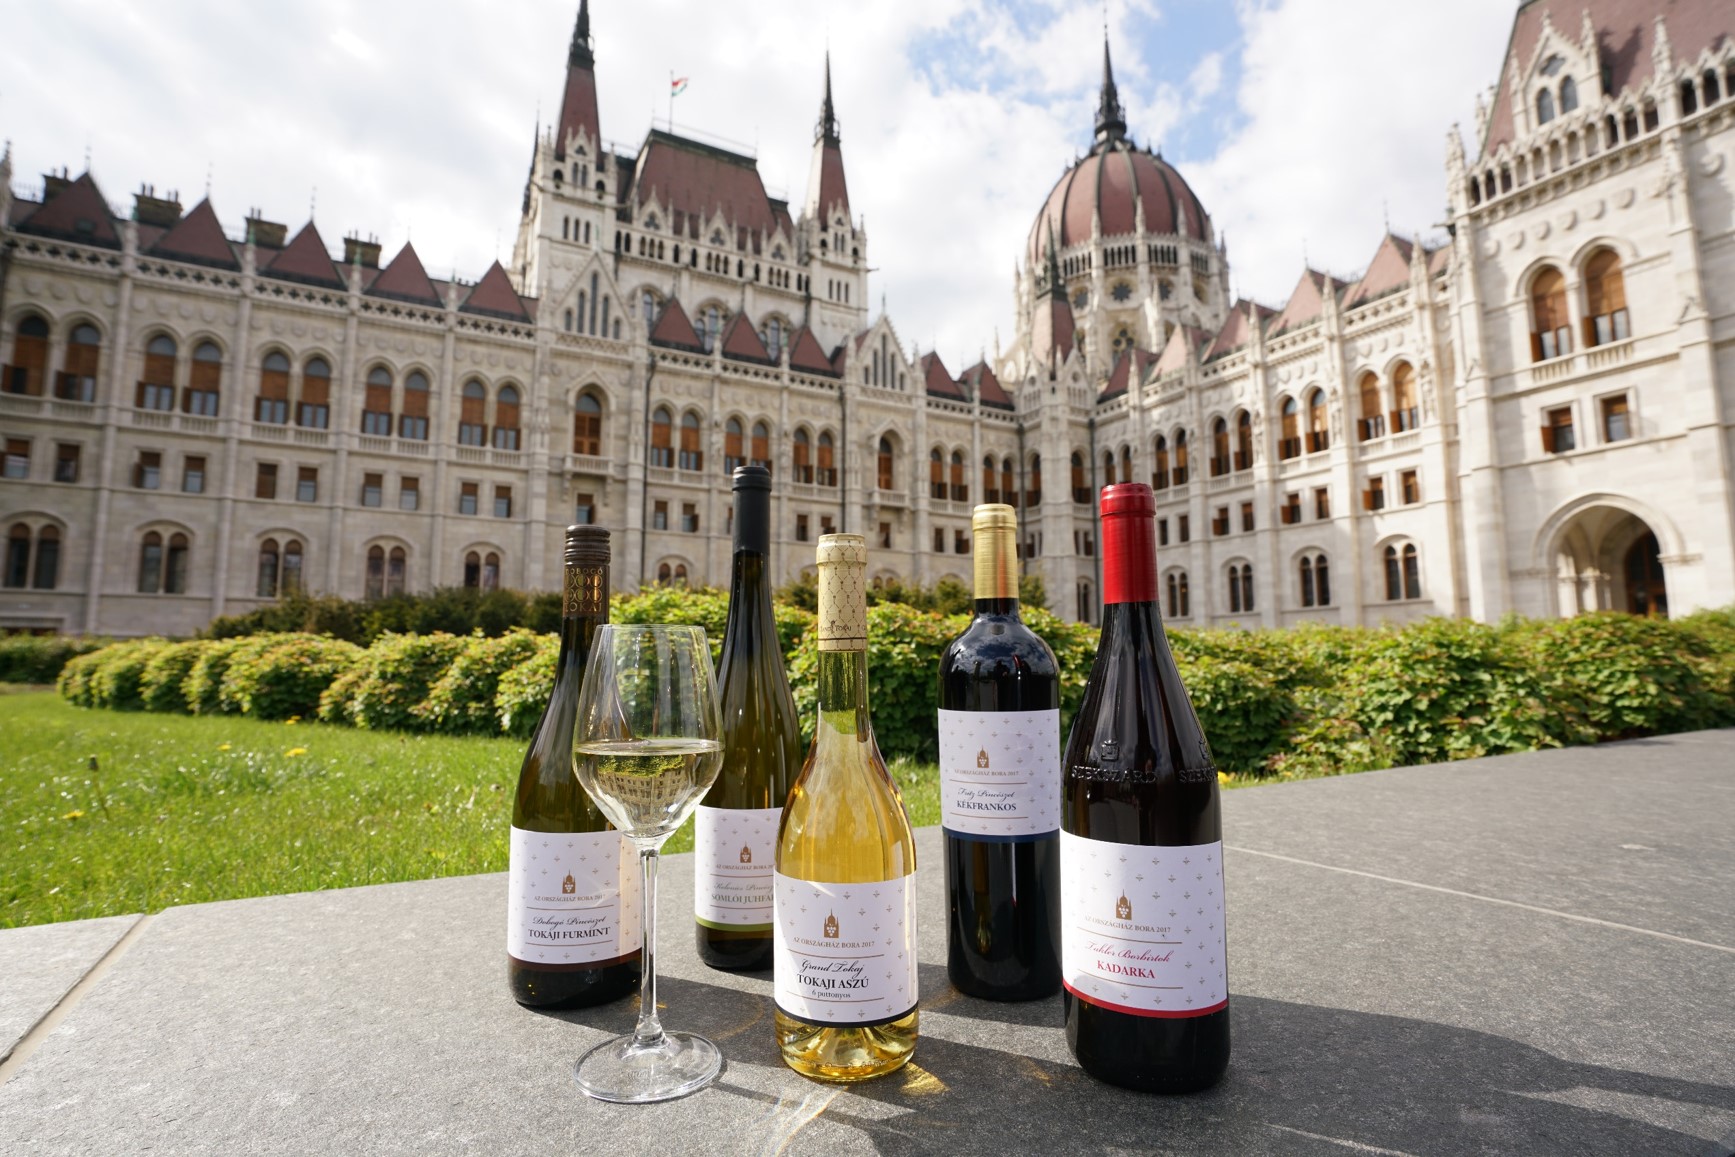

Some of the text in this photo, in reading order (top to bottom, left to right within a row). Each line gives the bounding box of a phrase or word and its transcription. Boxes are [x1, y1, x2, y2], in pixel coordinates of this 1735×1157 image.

[956, 799, 1017, 811] KÉKFRANKOS
[532, 914, 606, 930] Dobogó Pincészet
[562, 926, 611, 939] FURMINT
[1134, 925, 1156, 933] BORA
[861, 940, 875, 948] 2017
[1117, 949, 1175, 962] Borbirtok
[800, 958, 865, 979] Grand Tokaj
[1097, 960, 1156, 979] KADARKA
[797, 973, 869, 990] TOKAJI ASZÚ
[817, 990, 851, 999] puttonyos
